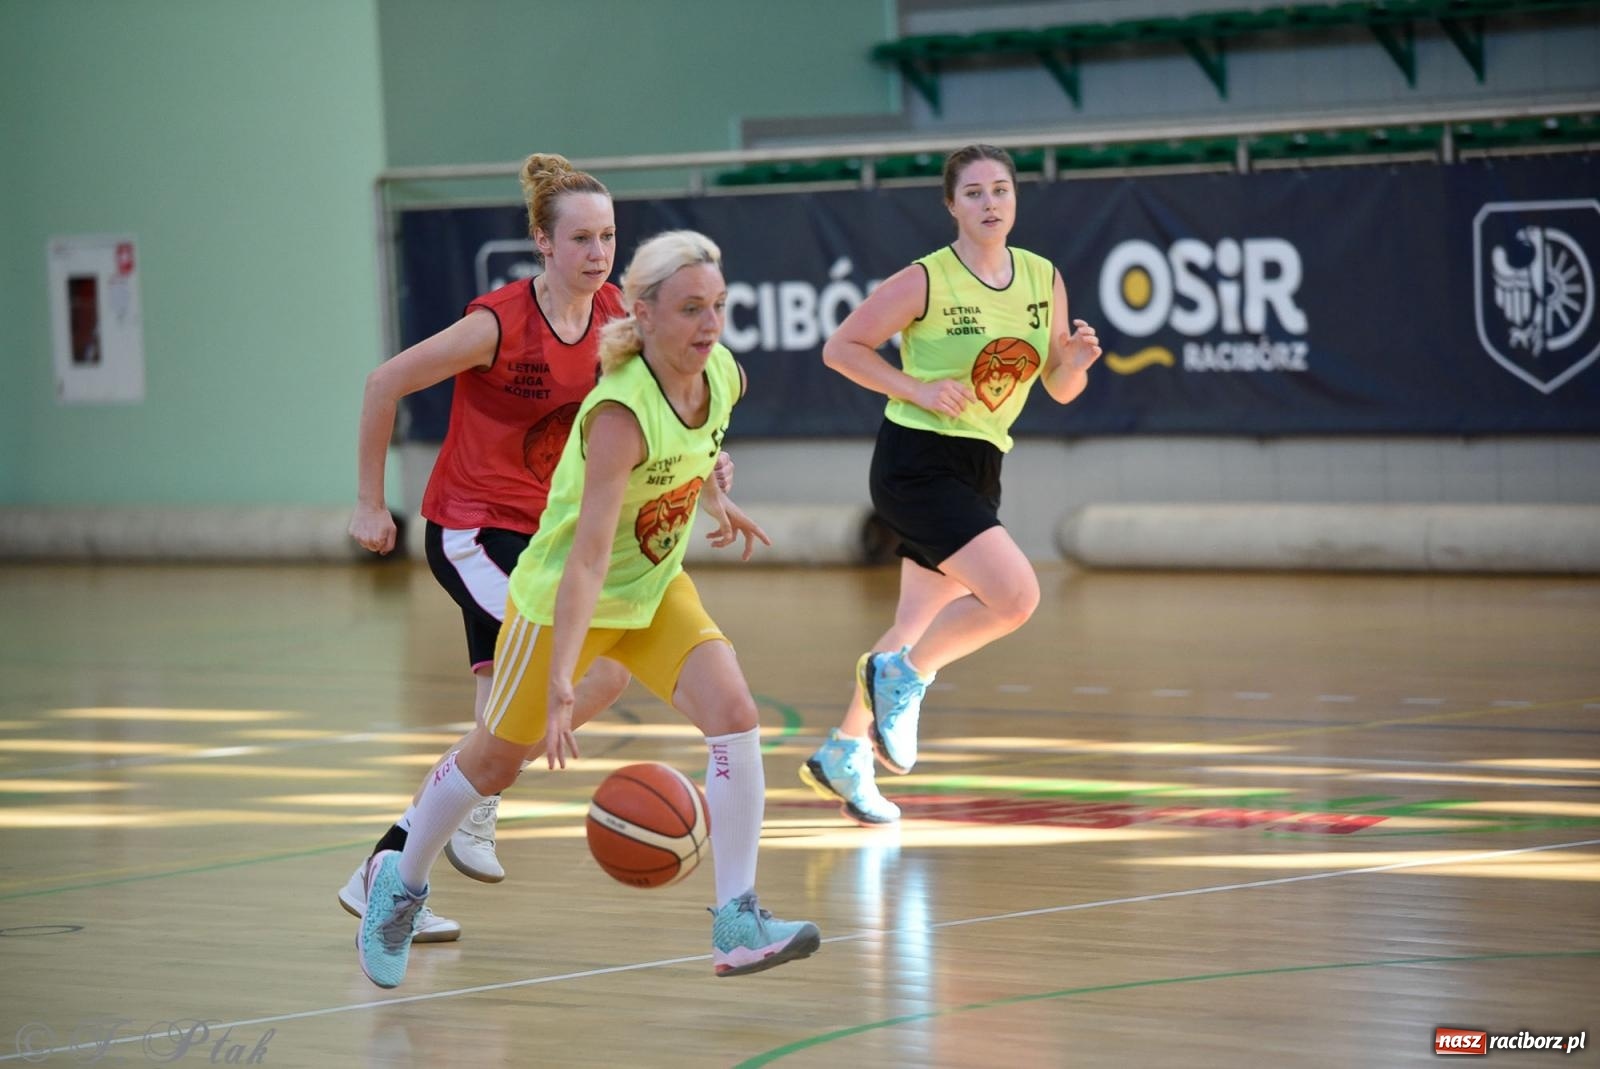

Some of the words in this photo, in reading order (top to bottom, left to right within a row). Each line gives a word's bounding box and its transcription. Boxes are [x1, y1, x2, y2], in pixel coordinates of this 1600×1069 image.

[943, 307, 982, 316] LETNIA
[1027, 301, 1048, 329] 37
[952, 316, 978, 325] LIGA
[946, 326, 986, 335] KOBIET
[1183, 335, 1308, 372] RACIBÓRZ
[508, 363, 551, 373] LETNIA
[514, 376, 543, 386] LIGA
[504, 385, 551, 399] KOBIET
